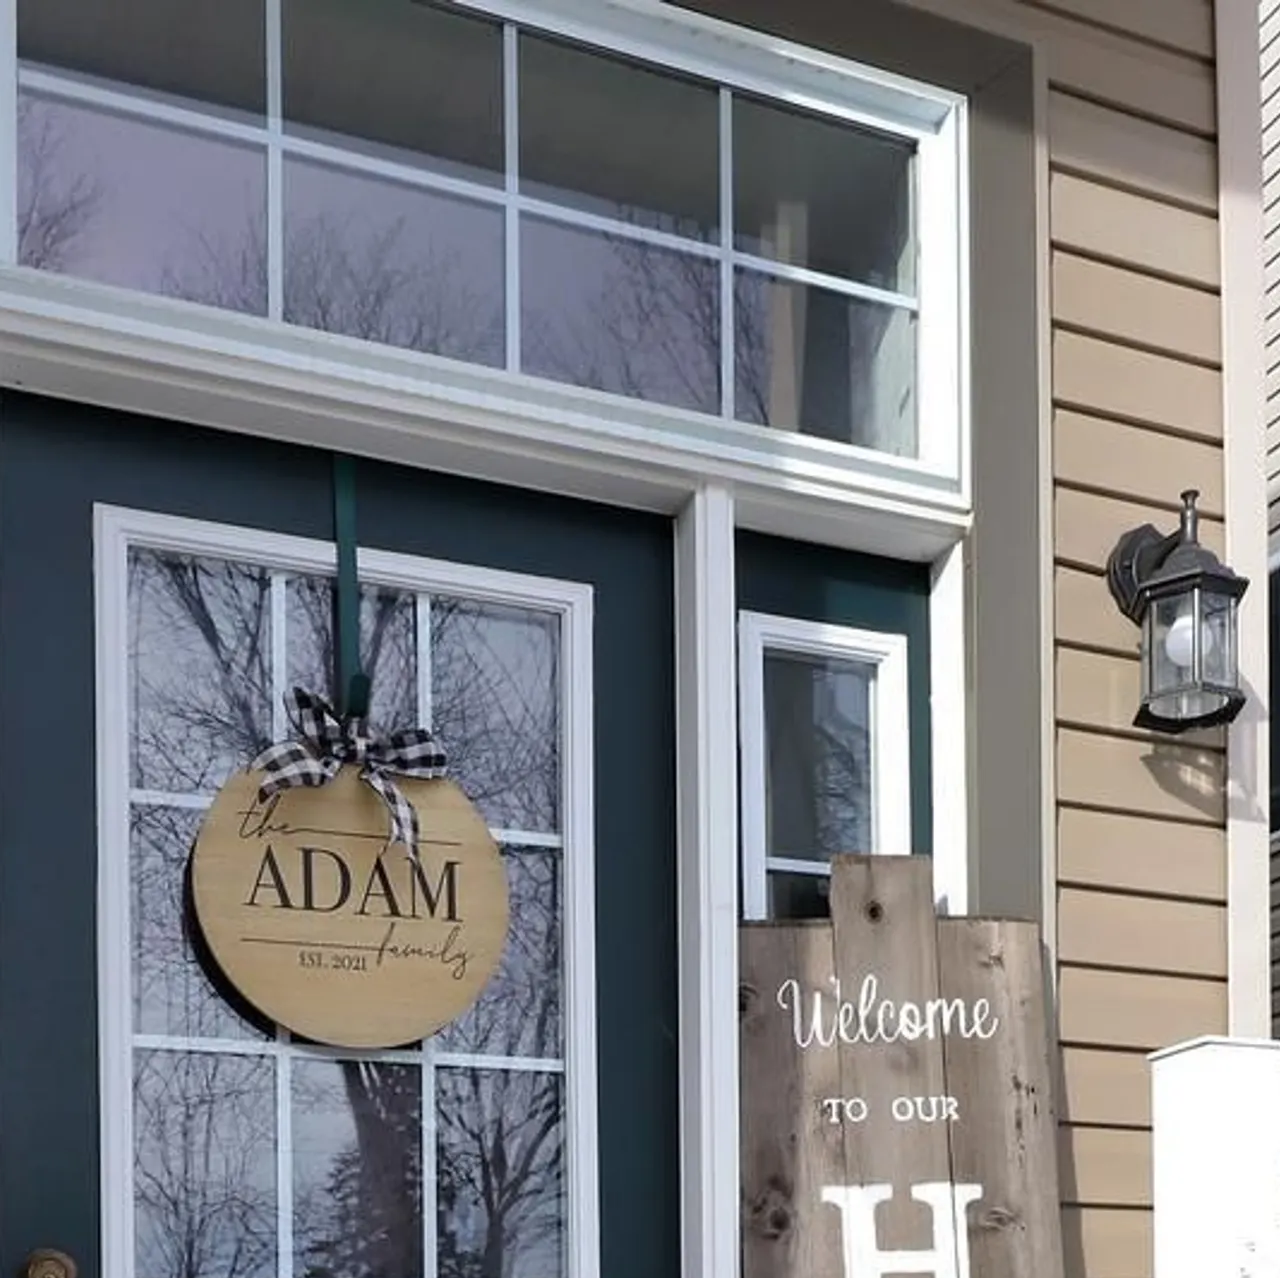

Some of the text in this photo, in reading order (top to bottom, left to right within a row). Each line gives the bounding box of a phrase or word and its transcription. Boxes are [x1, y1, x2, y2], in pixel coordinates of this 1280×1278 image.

[237, 795, 300, 840] the
[244, 845, 464, 923] ADAM
[298, 950, 368, 973] EST. 2021
[375, 922, 473, 980] family
[777, 974, 999, 1048] Welcome
[823, 1095, 960, 1124] TO OUR
